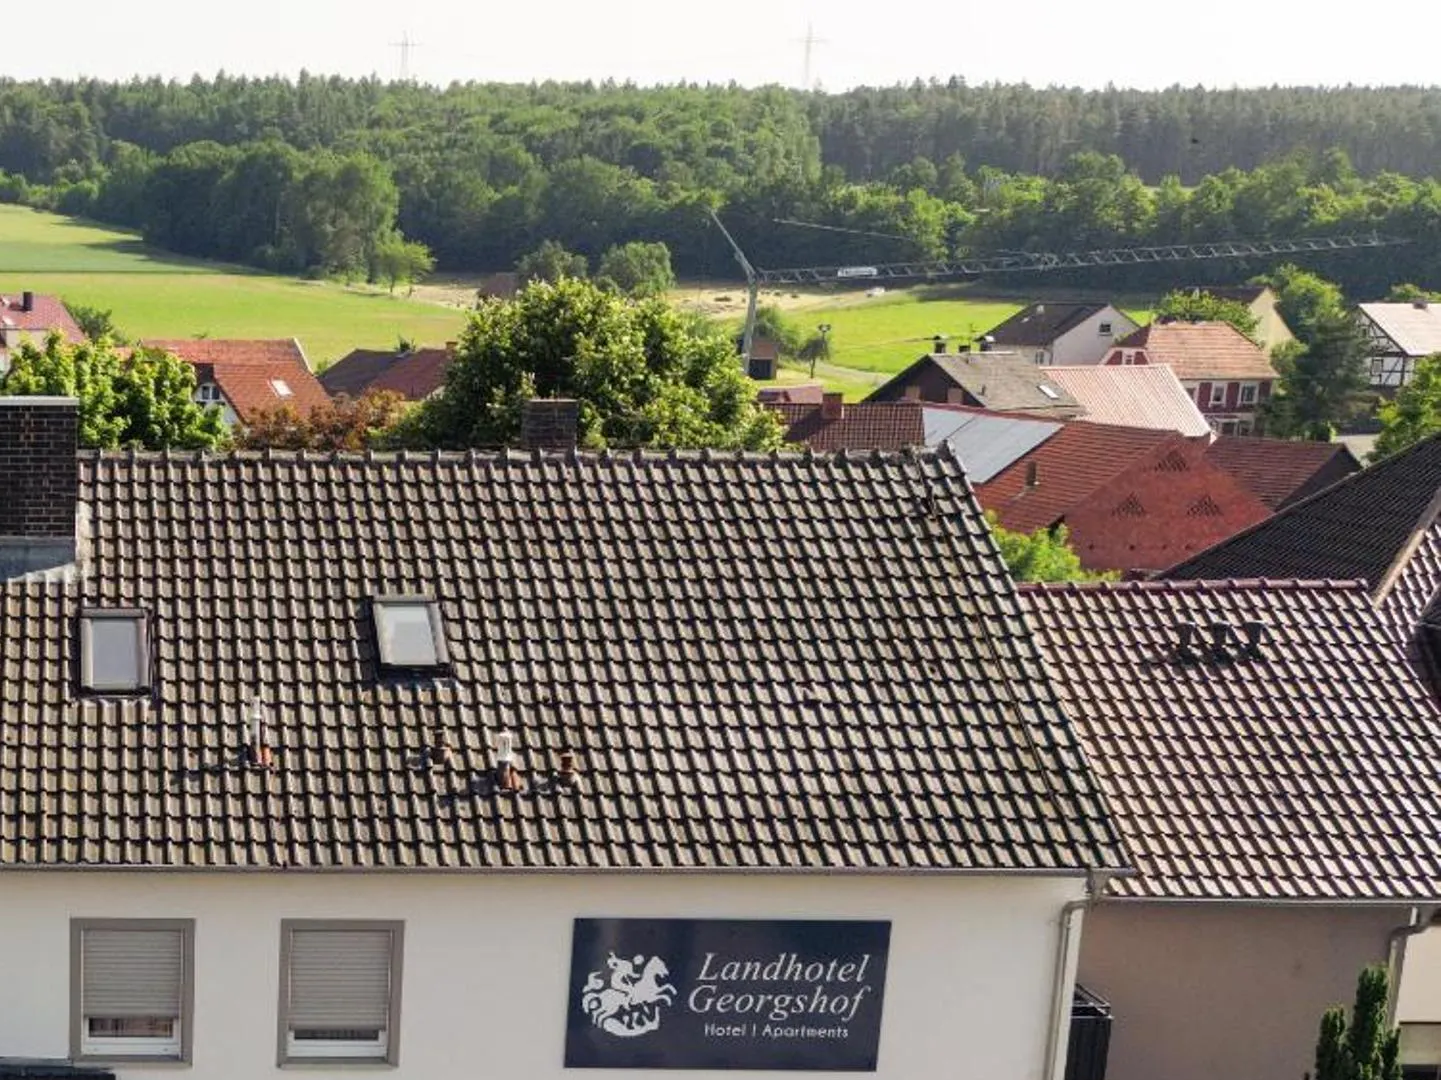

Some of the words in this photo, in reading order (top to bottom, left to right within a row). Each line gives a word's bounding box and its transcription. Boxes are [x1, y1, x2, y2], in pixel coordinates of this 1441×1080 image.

[696, 952, 871, 982] Landhotel
[688, 985, 872, 1022] Georgshof
[704, 1023, 746, 1037] Hotel
[762, 1023, 849, 1038] Apartments
